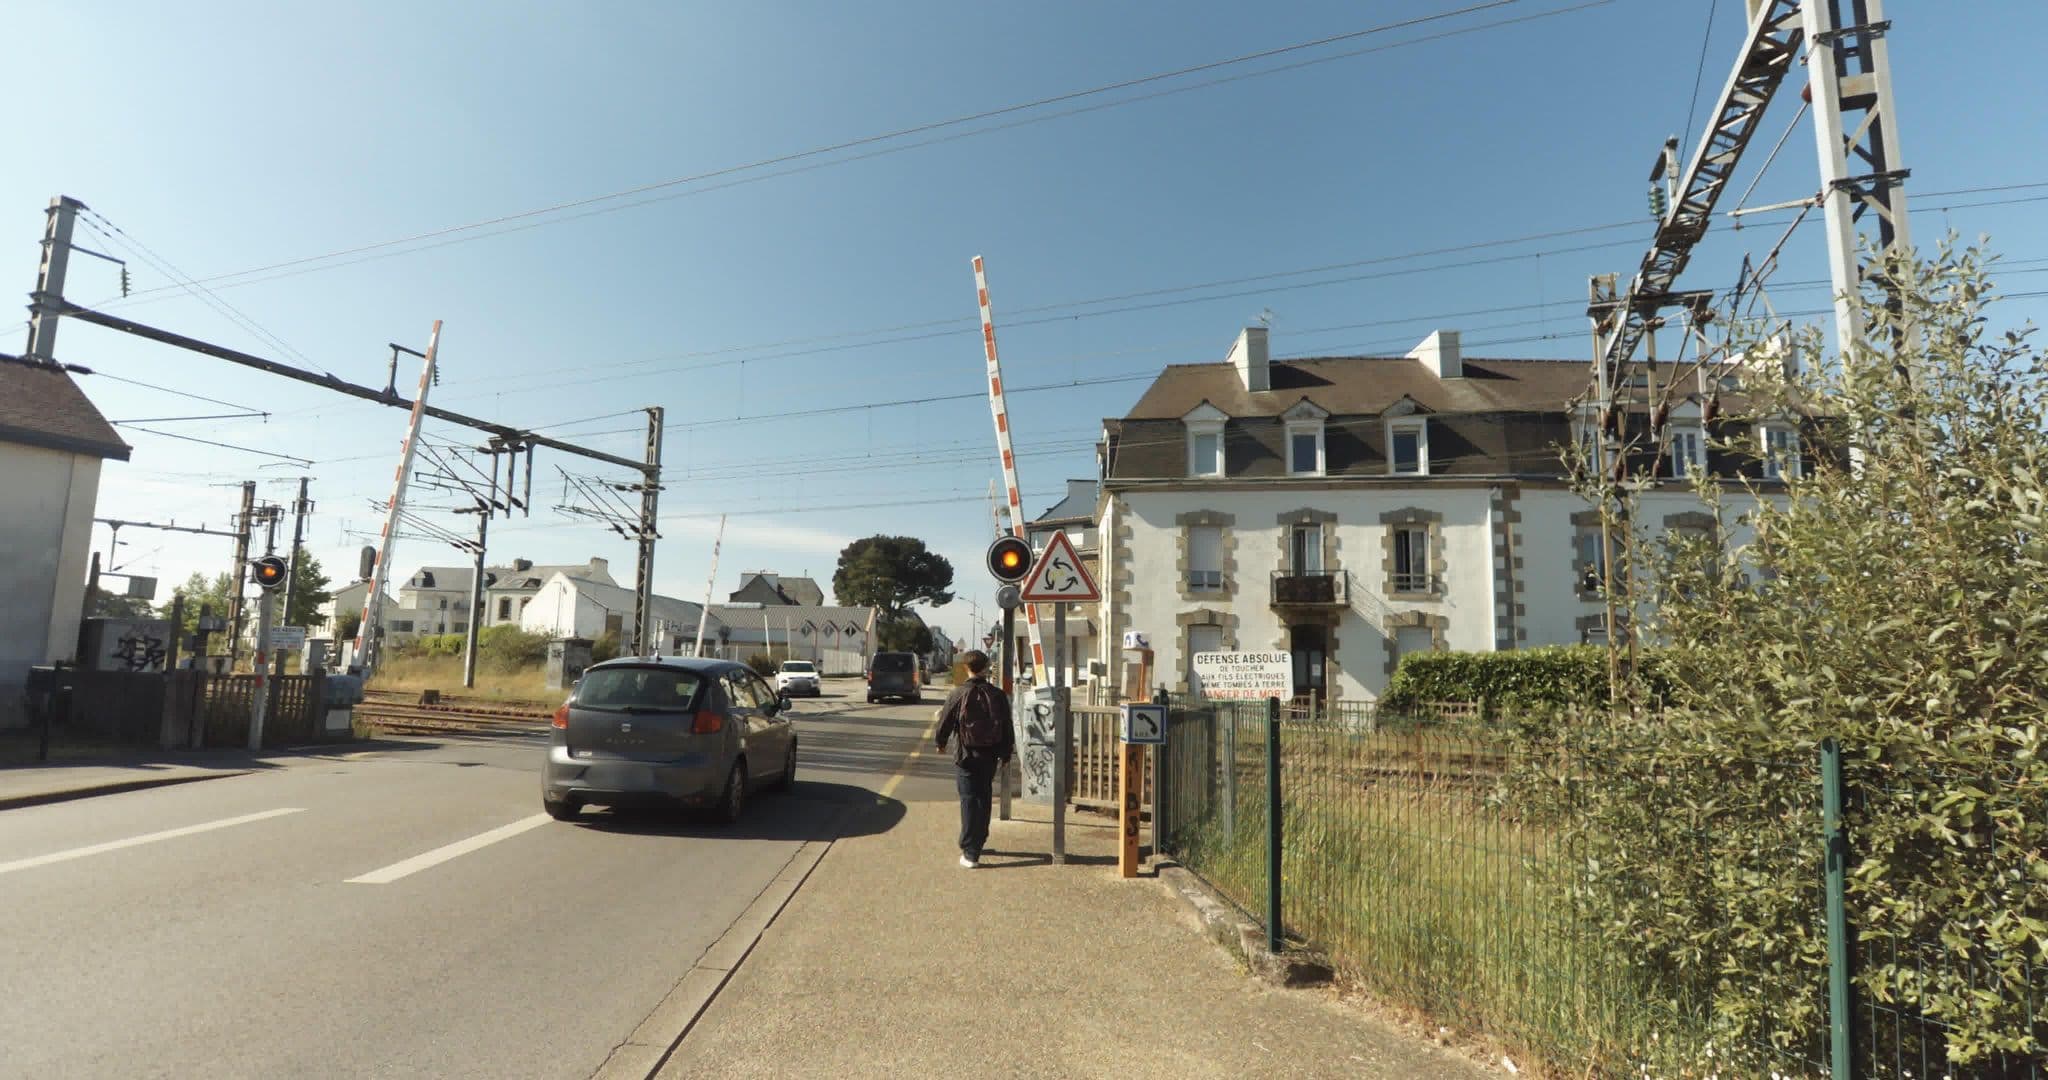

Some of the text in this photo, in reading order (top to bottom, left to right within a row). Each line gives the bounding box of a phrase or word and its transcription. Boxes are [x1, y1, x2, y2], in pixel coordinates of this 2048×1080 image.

[1242, 653, 1288, 664] ABSOLUE
[1200, 689, 1288, 698] DANGER DE MORT
